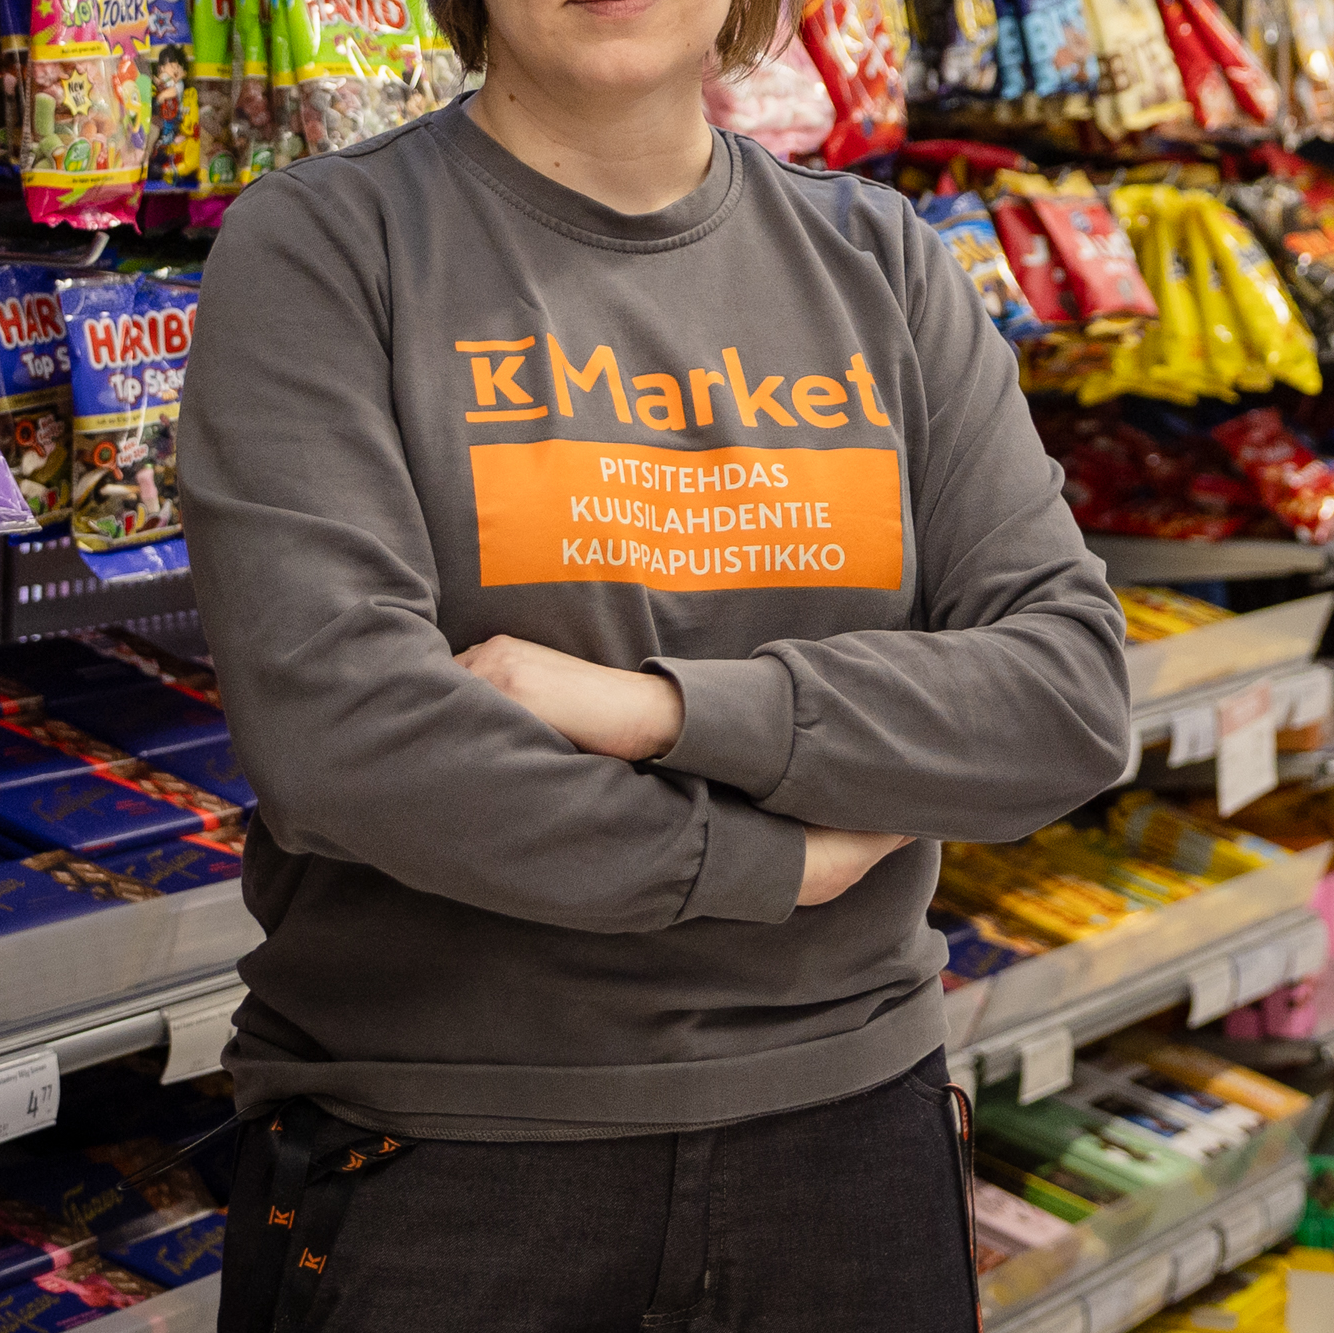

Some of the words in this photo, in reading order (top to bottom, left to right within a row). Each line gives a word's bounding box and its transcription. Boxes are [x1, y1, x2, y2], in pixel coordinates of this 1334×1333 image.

[68, 81, 85, 94] New
[85, 303, 197, 371] HARIB
[21, 350, 54, 380] Top
[547, 332, 891, 432] Market
[110, 372, 143, 404] Tp
[600, 456, 789, 493] PITSITEHDAS
[570, 495, 832, 536] KUUSILAHDENTIE
[562, 539, 846, 577] KAUPPAPUISTIKKO
[27, 1089, 38, 1118] 4
[41, 1084, 53, 1103] 77
